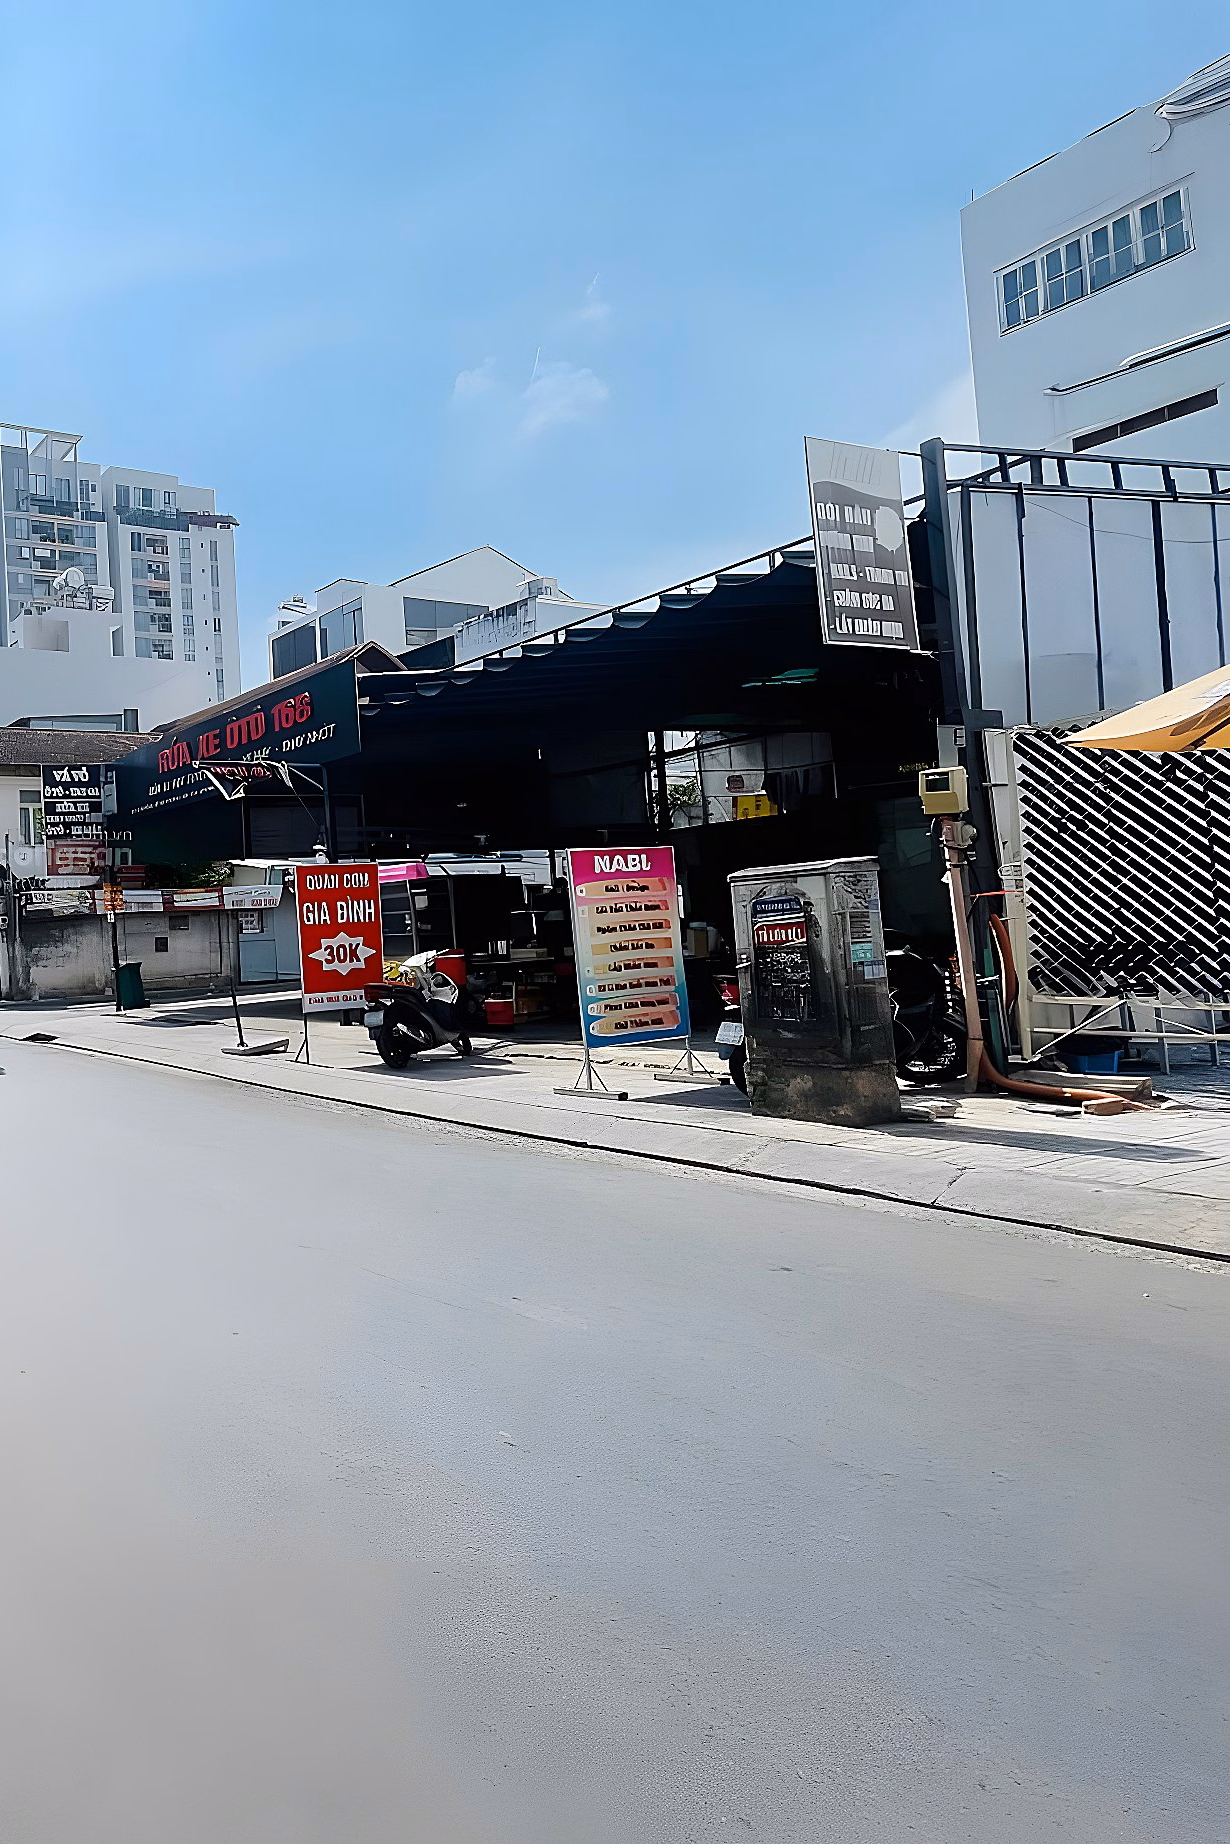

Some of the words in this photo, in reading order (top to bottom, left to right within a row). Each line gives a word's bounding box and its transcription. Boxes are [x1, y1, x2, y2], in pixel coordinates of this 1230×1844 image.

[303, 901, 331, 925] GIA
[336, 895, 375, 923] ĐÌNH
[324, 942, 363, 964] 30K
